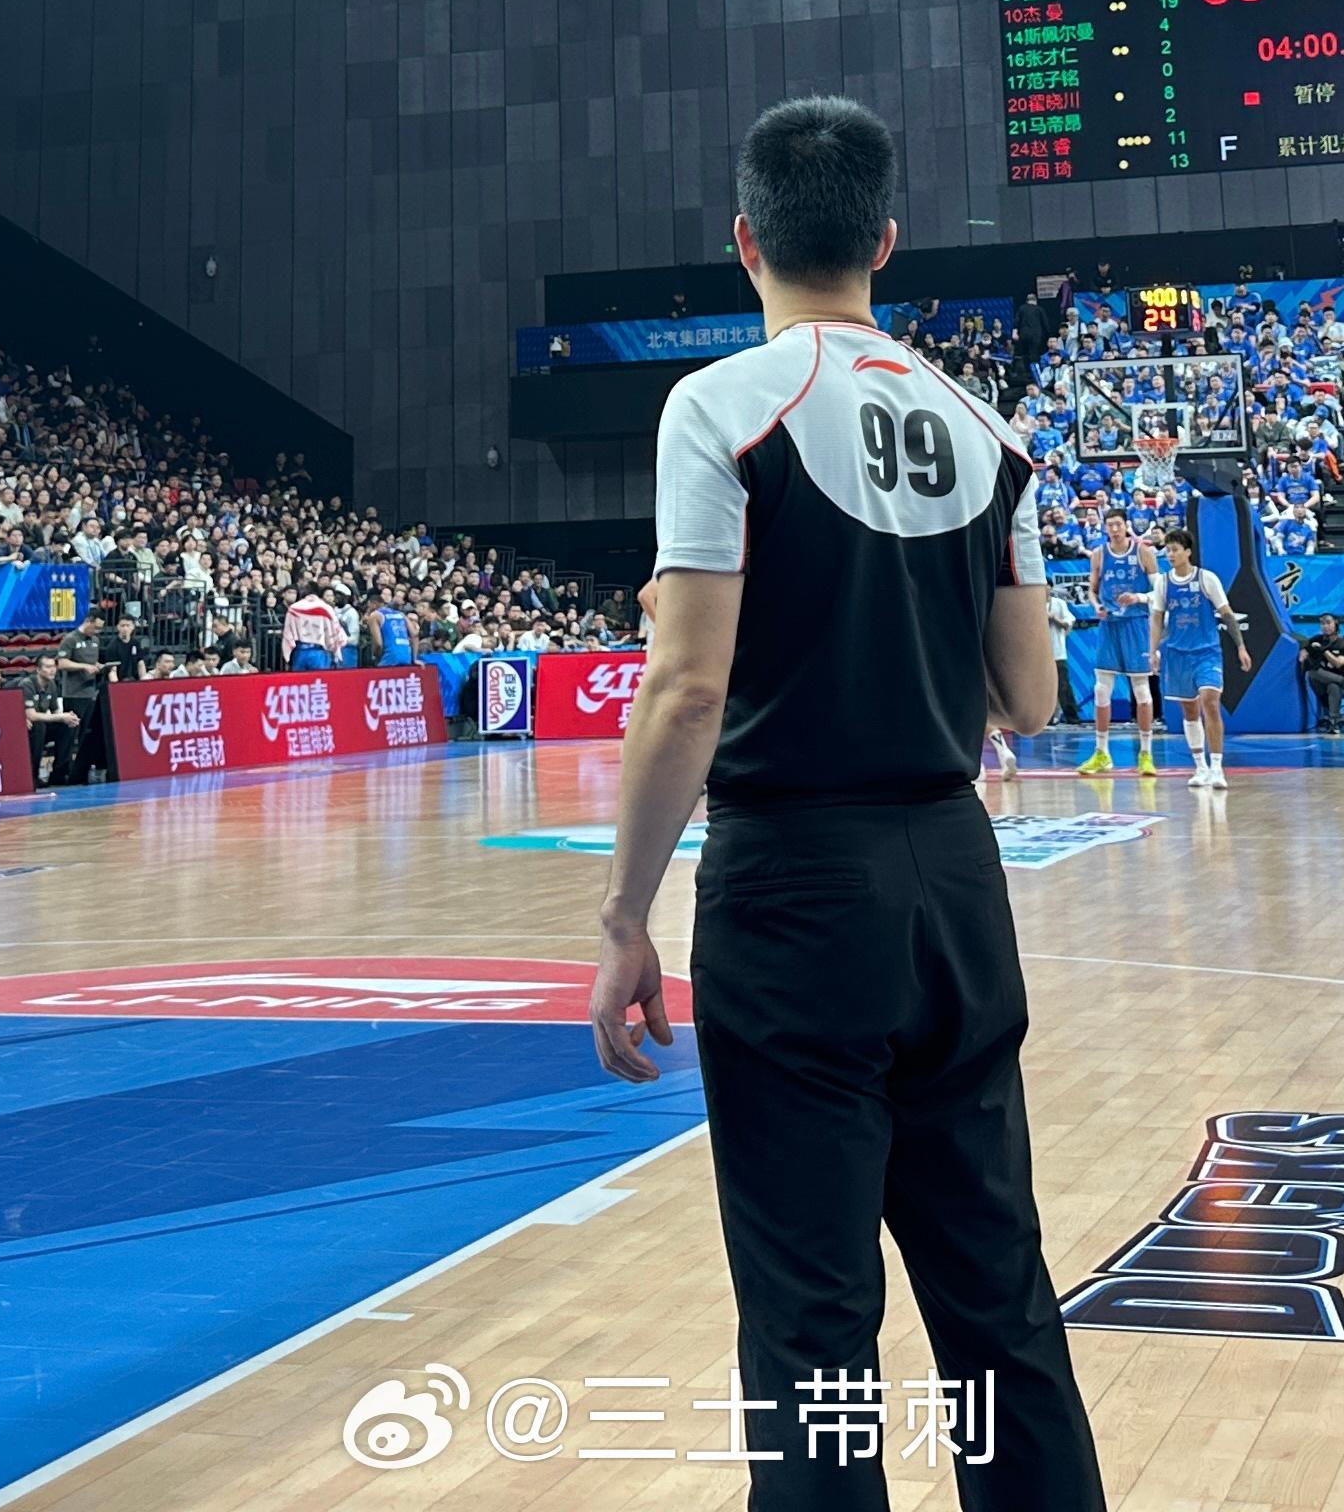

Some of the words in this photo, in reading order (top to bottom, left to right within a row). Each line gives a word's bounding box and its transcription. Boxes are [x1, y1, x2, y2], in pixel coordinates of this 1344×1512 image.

[1159, 18, 1169, 32] 4
[1161, 40, 1172, 54] 2
[1163, 63, 1173, 77] 0
[1164, 86, 1175, 100] 8
[1293, 82, 1336, 105] 暂停
[1165, 109, 1176, 123] 2
[1168, 130, 1186, 145] 11
[1219, 135, 1238, 161] F
[1169, 153, 1190, 168] 13
[1144, 308, 1176, 332] 24
[859, 401, 957, 498] 99
[1054, 573, 1090, 584] DUCK
[365, 672, 425, 732] 红双喜
[503, 672, 517, 711] 百岁山
[140, 685, 222, 756] 红双喜
[261, 676, 331, 742] 红双喜
[285, 725, 335, 758] 足篮排球
[169, 736, 227, 773] 乒乓器材
[20, 990, 550, 1013] LI-NING
